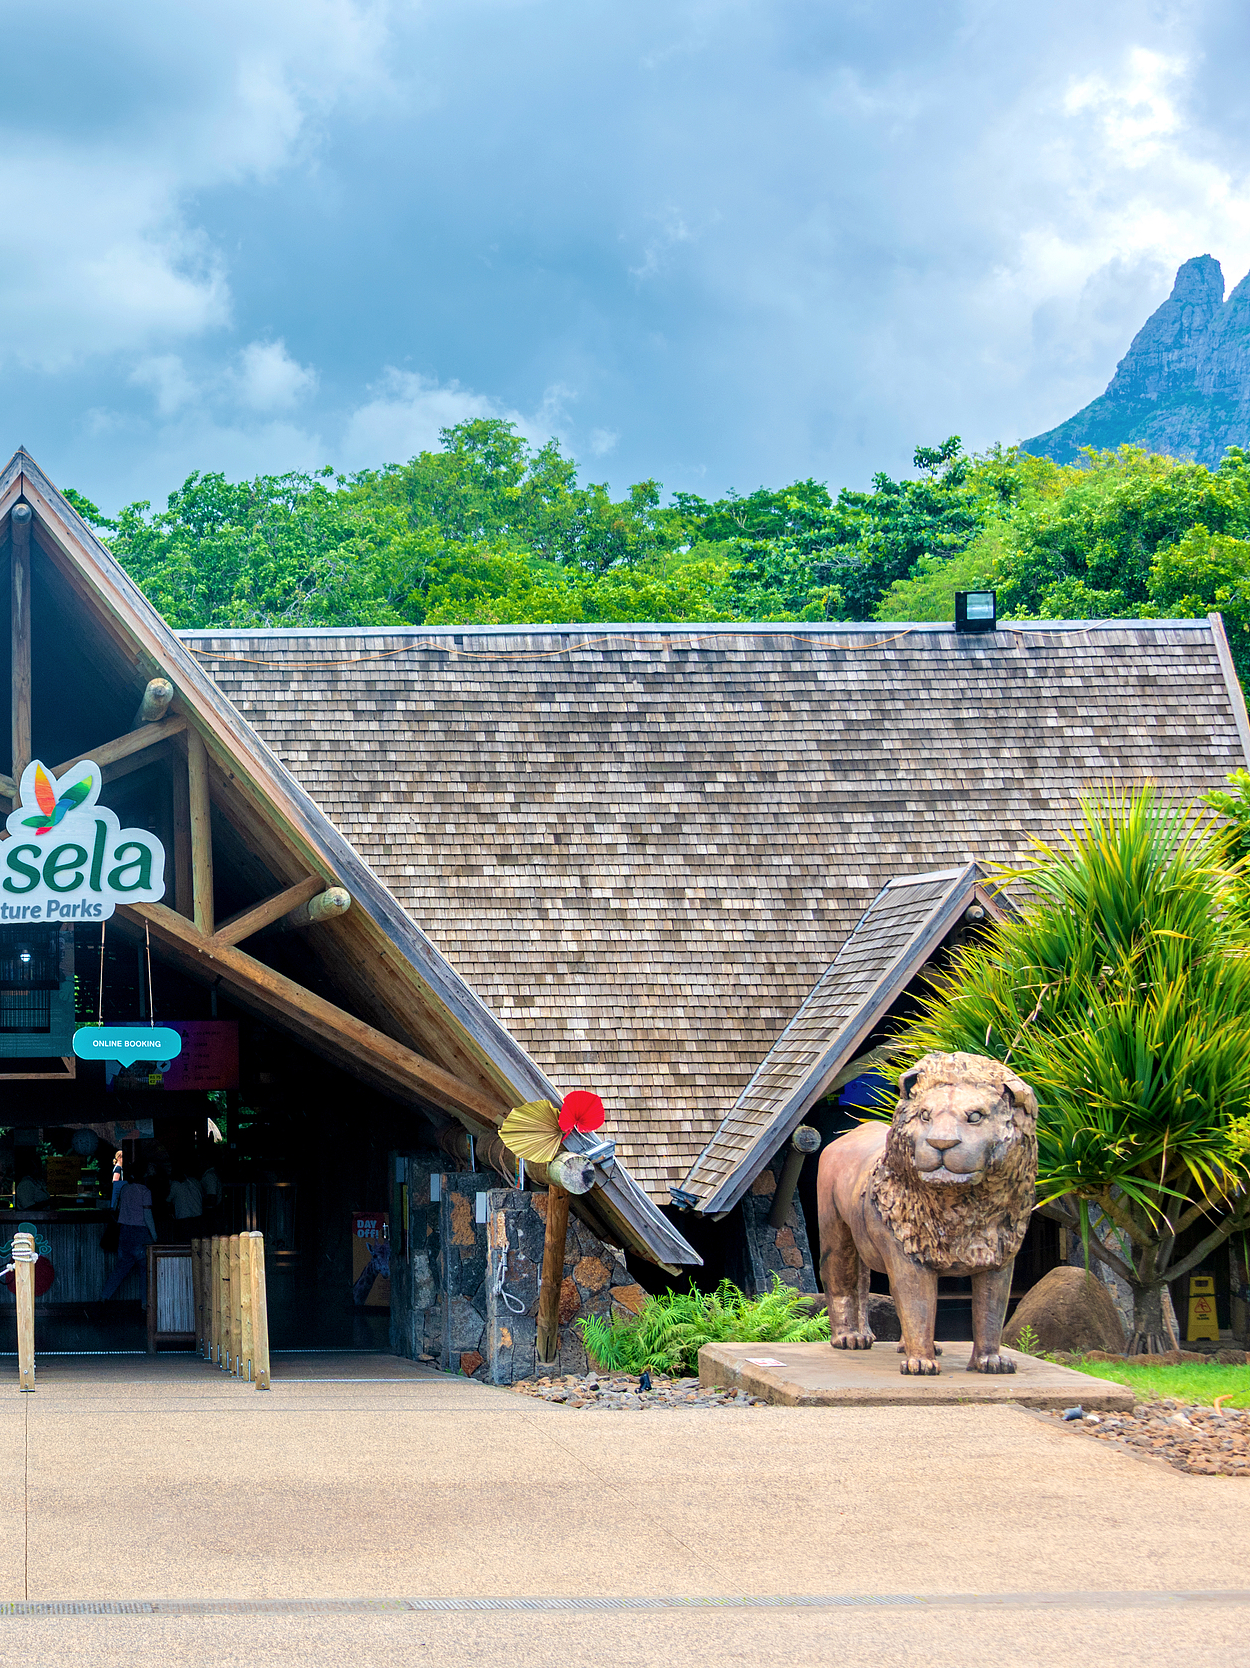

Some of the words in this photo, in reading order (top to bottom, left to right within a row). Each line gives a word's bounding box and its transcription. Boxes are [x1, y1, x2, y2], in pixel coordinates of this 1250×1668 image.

[46, 899, 103, 919] Parks
[124, 1040, 162, 1048] BOOKING
[357, 1219, 377, 1229] DAY
